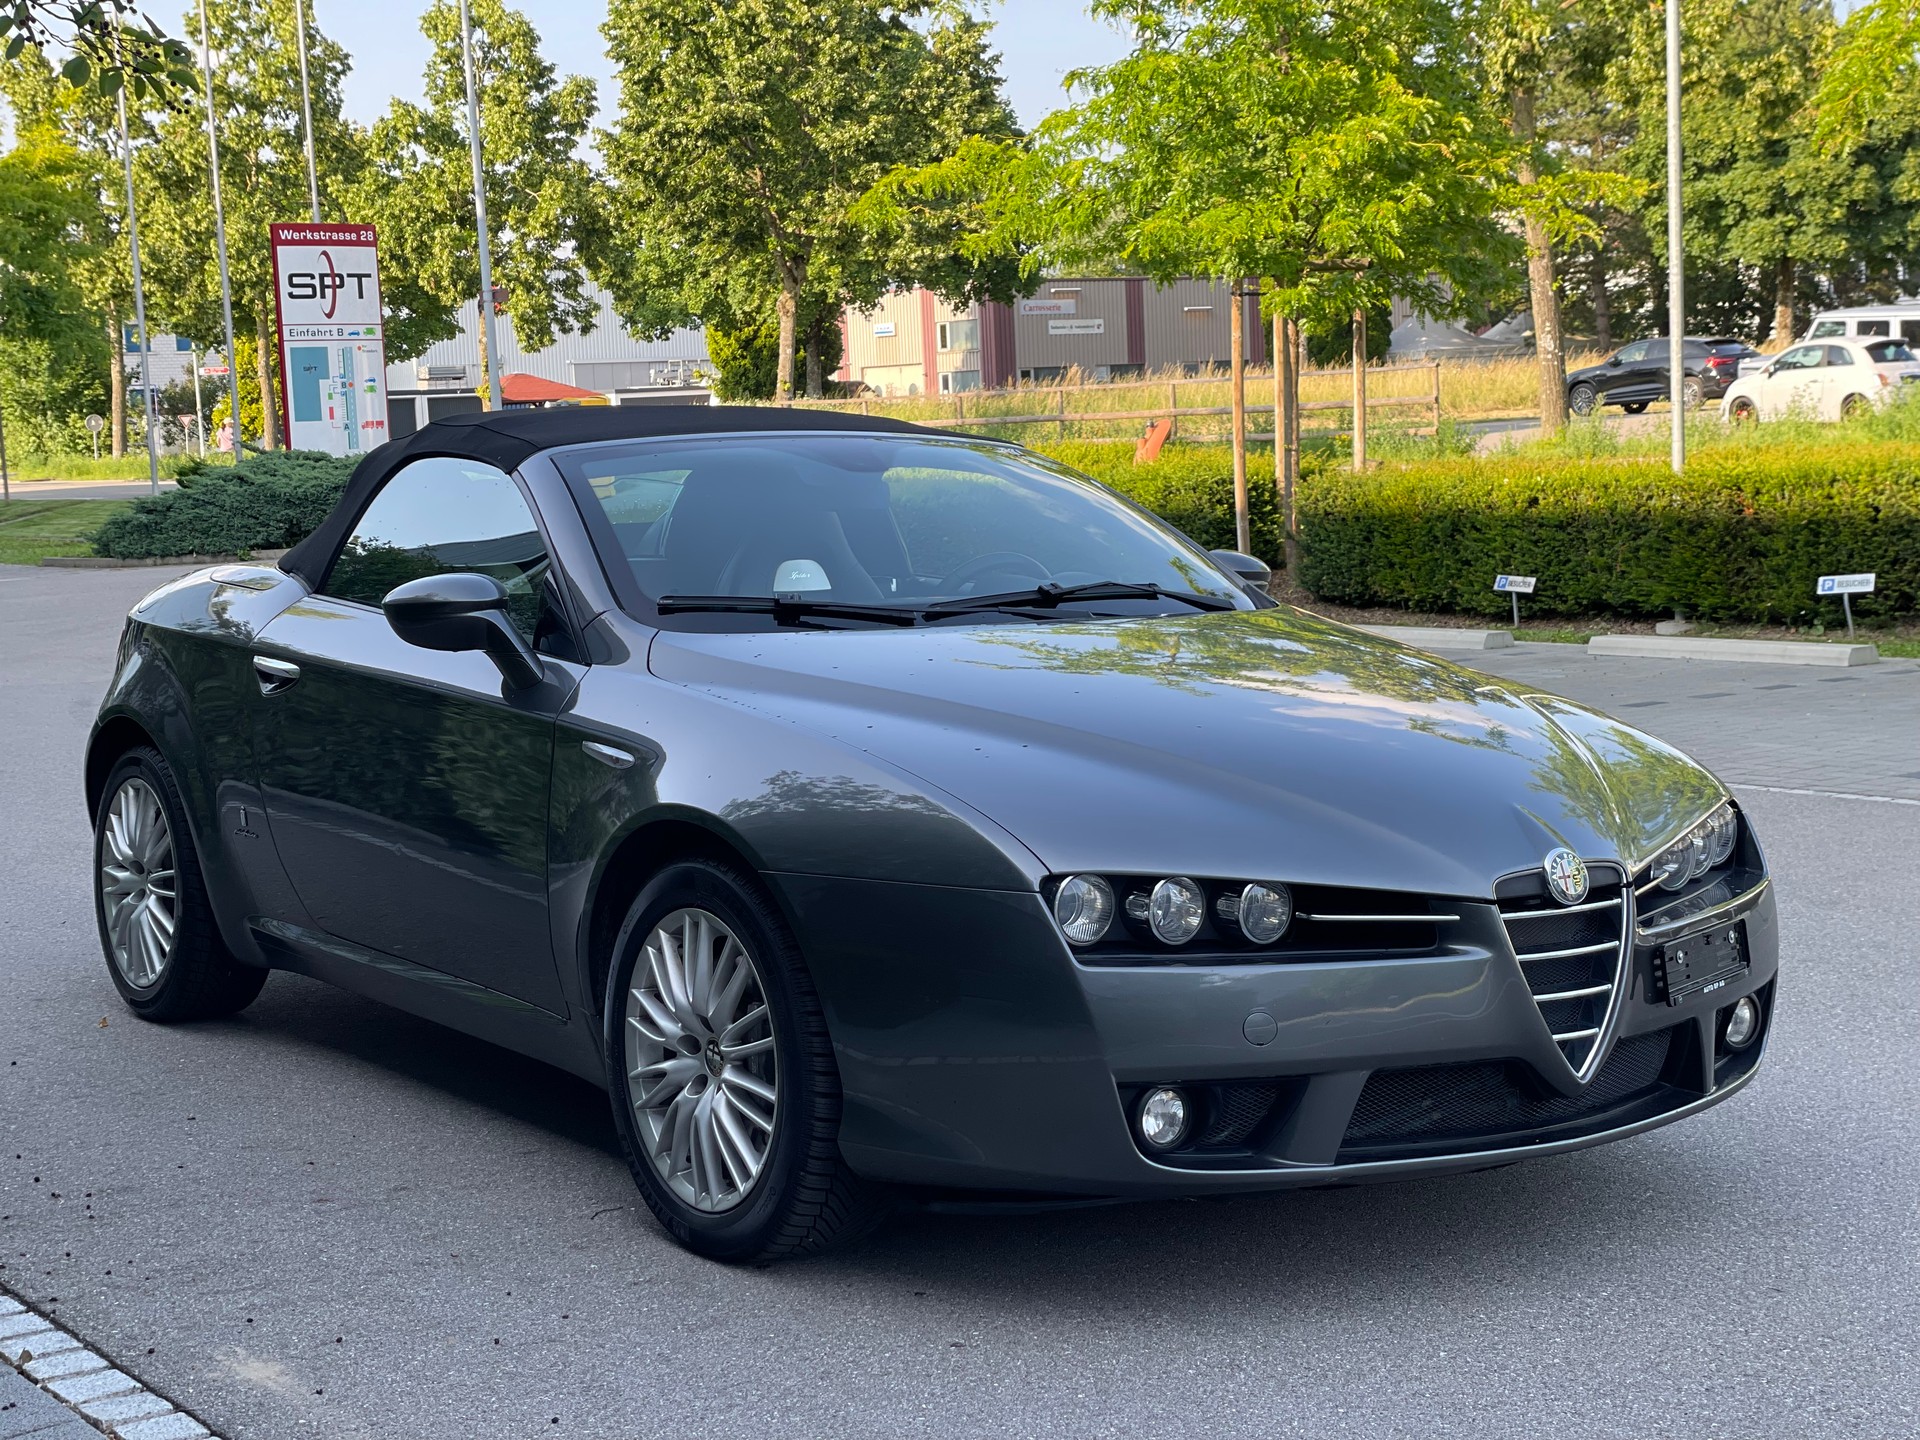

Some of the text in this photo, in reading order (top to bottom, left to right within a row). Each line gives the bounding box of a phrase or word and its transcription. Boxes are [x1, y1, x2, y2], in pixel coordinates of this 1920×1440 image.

[279, 229, 374, 241] Werkstrasse 28
[287, 272, 372, 299] SPT
[289, 328, 344, 337] Einfahrt B
[344, 423, 350, 431] A
